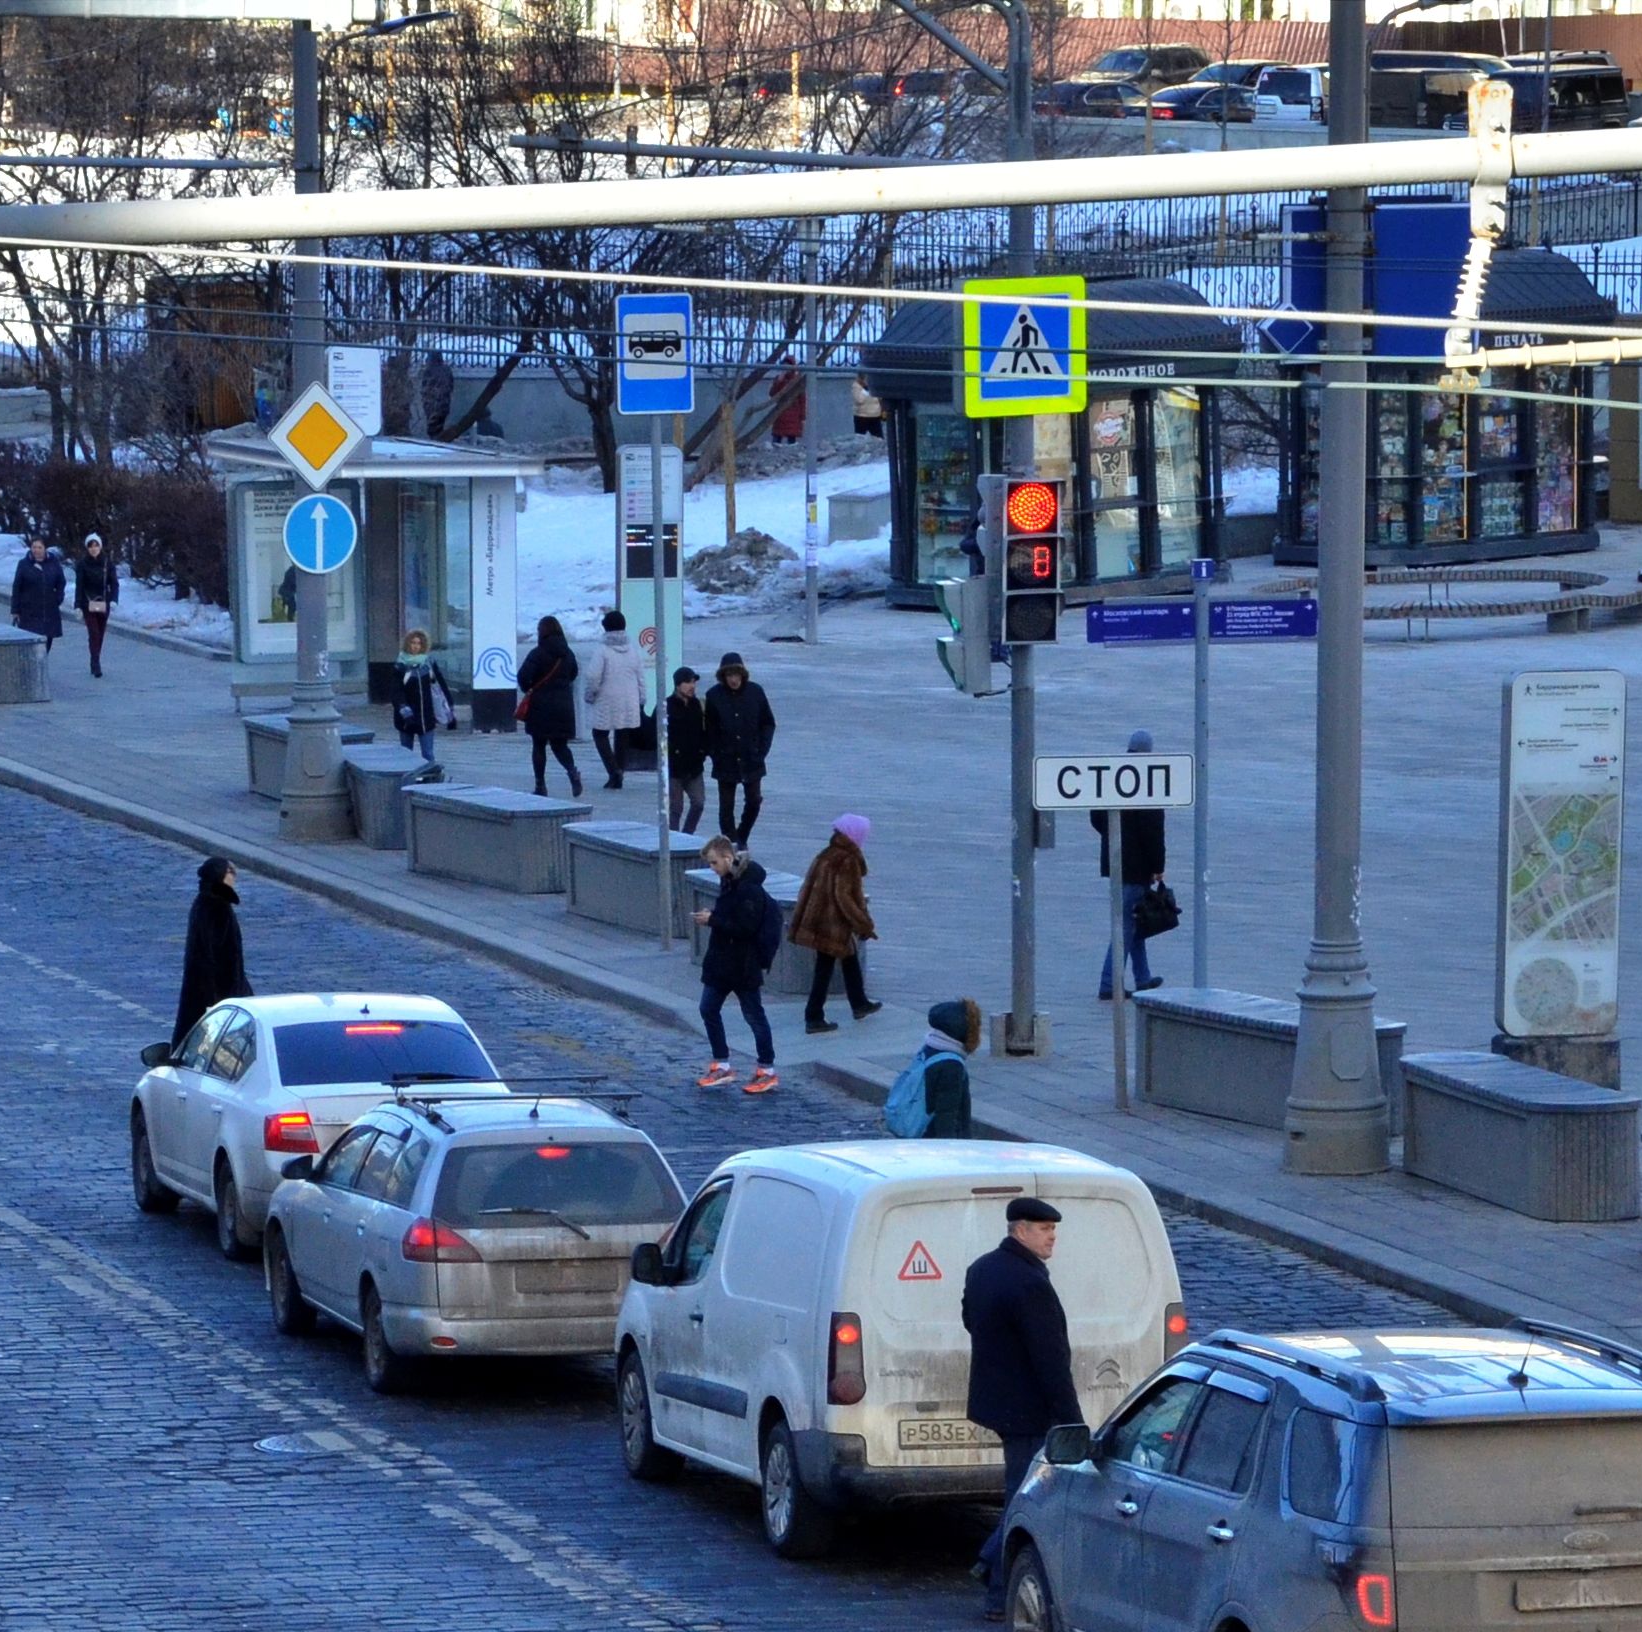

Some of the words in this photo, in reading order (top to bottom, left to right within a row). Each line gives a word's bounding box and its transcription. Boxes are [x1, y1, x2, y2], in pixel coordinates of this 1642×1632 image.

[1493, 332, 1544, 348] ПЕЧАТЬ
[1033, 545, 1050, 577] 8
[1057, 764, 1171, 799] СТОП
